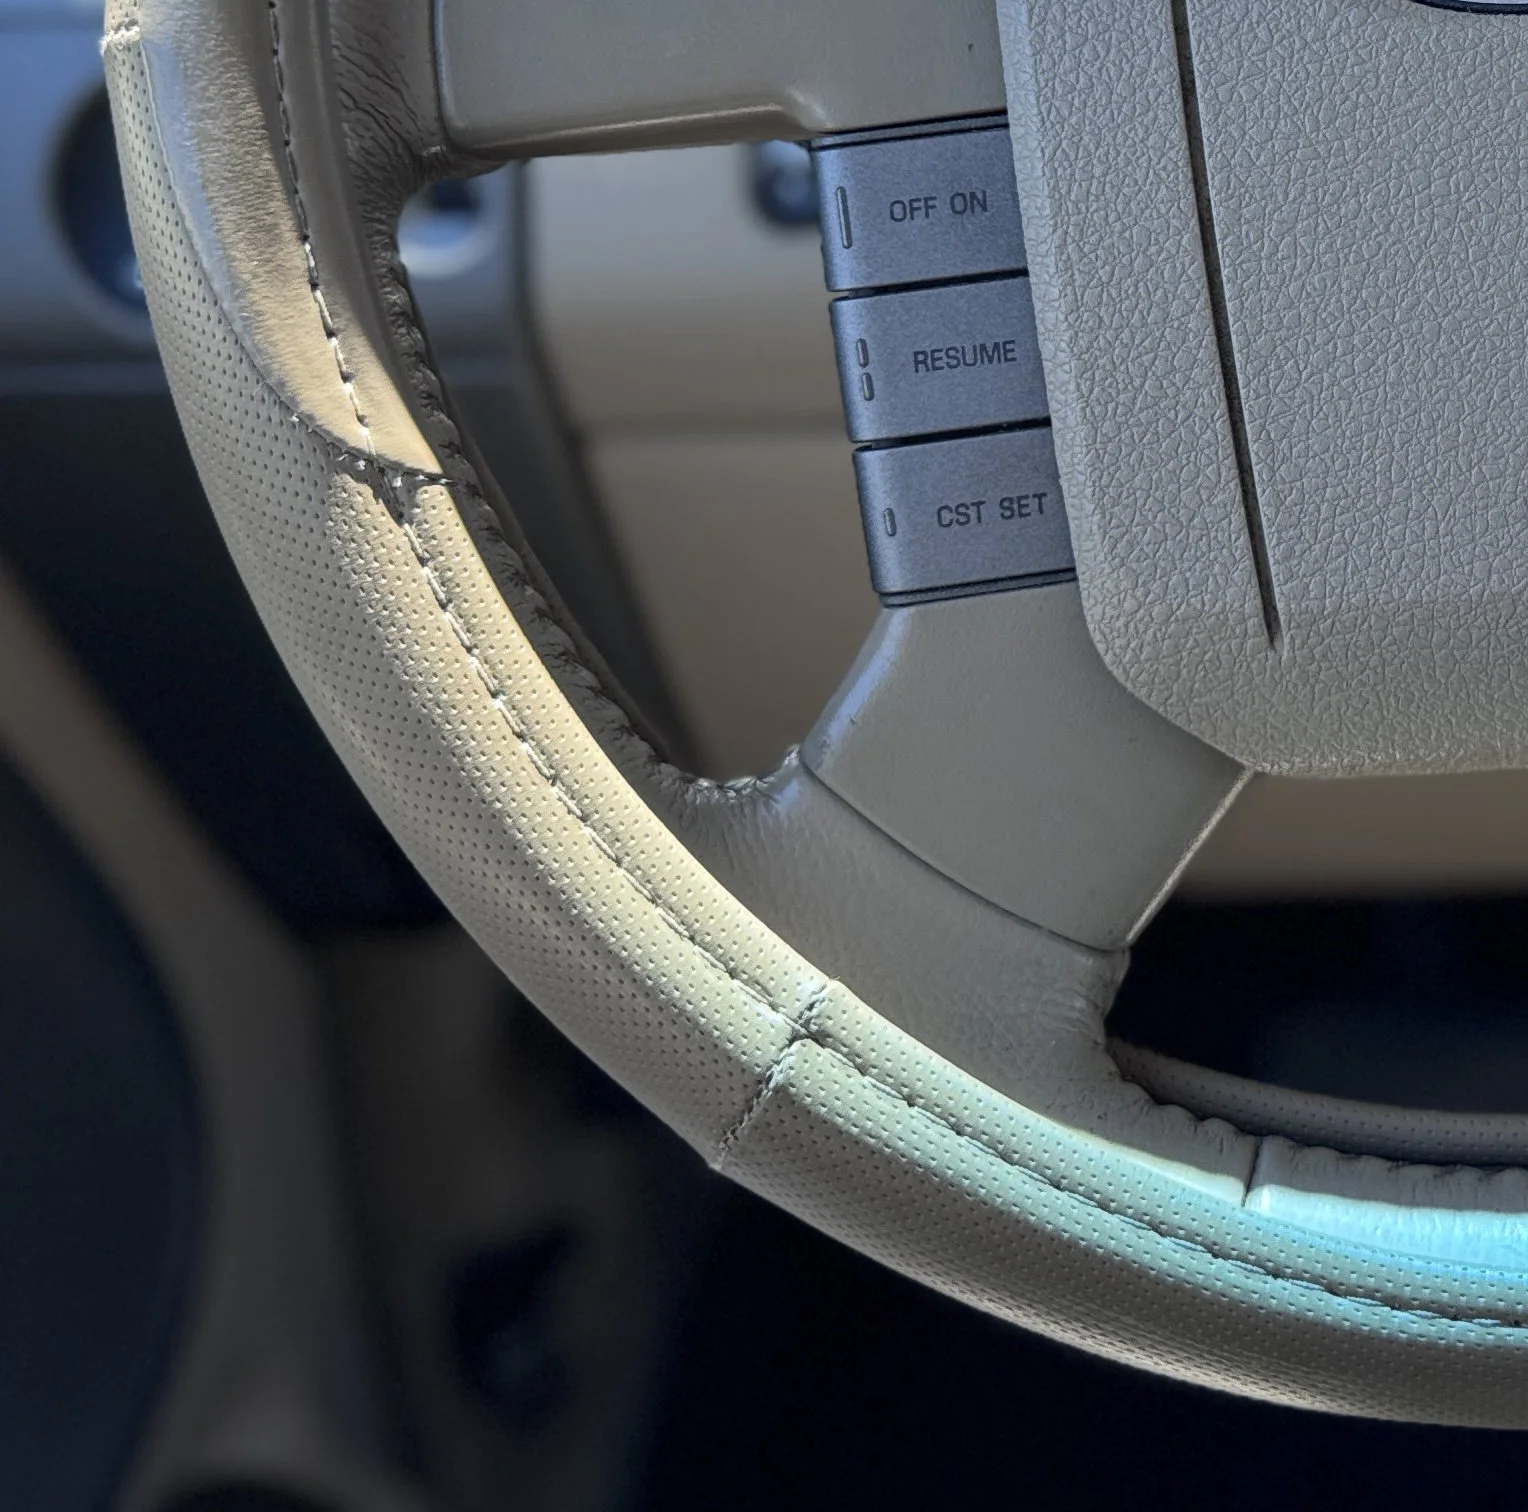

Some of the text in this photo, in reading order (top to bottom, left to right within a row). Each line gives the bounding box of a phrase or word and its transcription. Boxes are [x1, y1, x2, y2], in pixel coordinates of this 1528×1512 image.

[889, 190, 988, 223] OFF ON
[913, 339, 1017, 373] RESUME
[936, 492, 1048, 529] CST SET
